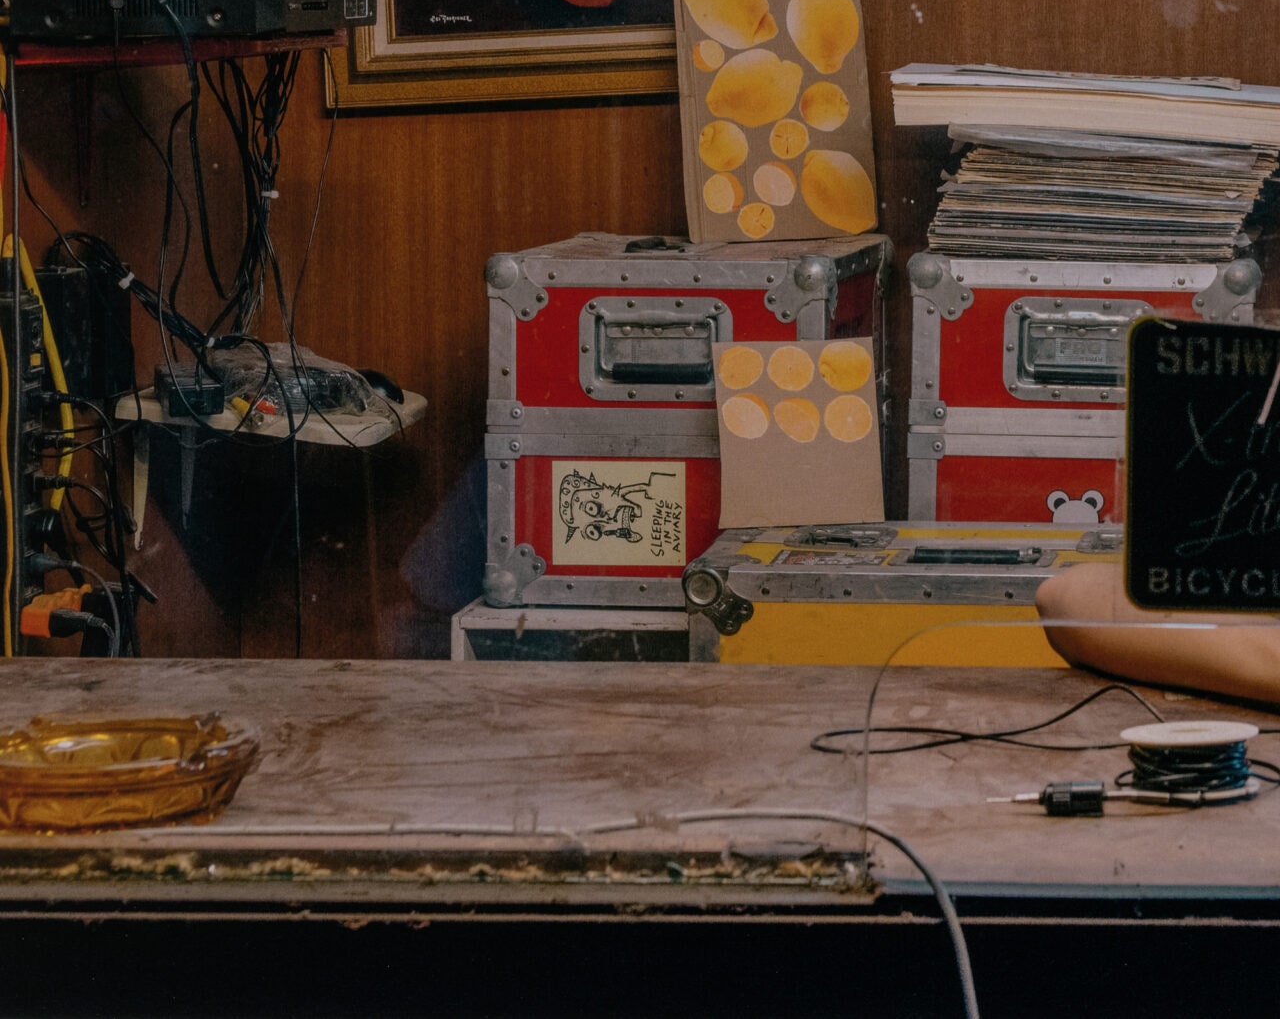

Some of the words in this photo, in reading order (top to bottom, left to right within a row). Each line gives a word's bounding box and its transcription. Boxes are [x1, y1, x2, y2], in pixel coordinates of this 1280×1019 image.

[651, 499, 665, 557] SLEEPING
[664, 500, 674, 525] THE
[672, 501, 683, 553] AVIARY
[664, 532, 672, 545] IN
